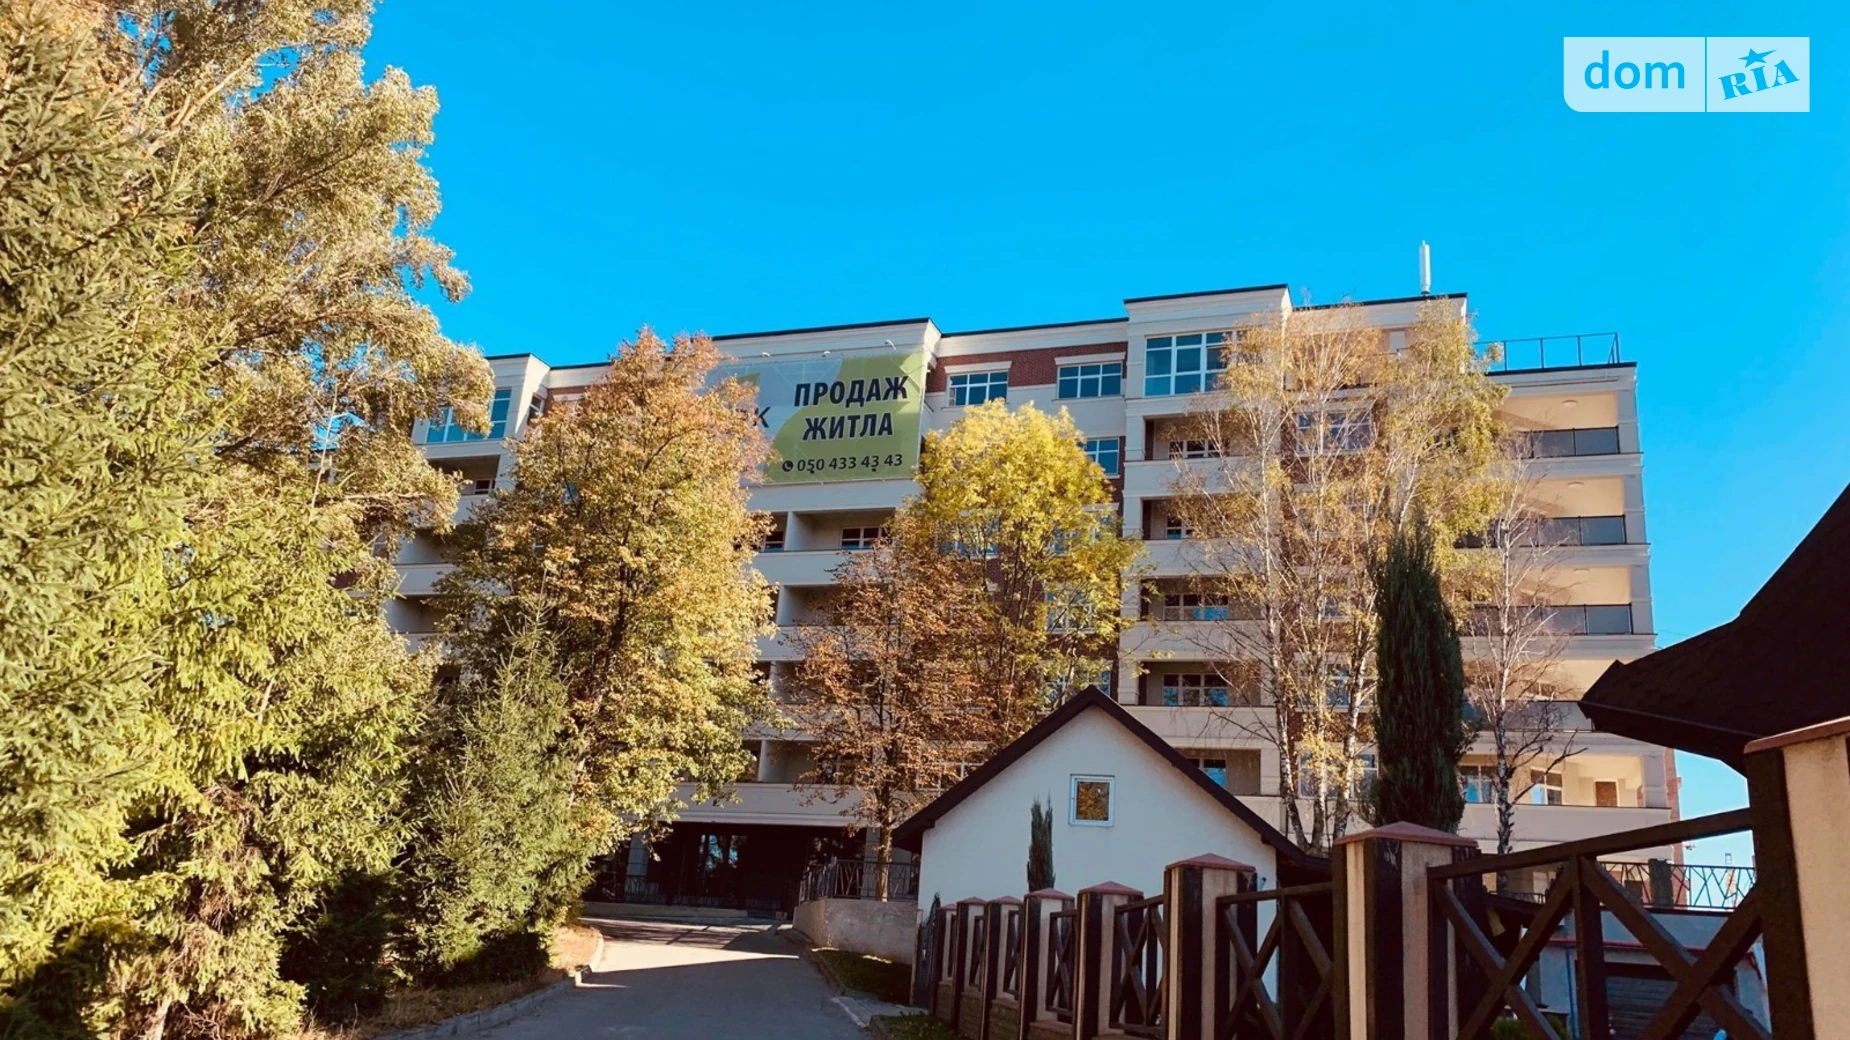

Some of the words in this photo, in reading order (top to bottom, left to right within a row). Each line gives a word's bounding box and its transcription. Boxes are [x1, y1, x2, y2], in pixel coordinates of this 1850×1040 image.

[794, 375, 908, 408] ПРОДАЖ
[802, 412, 893, 441] ЖИТЛА
[797, 458, 825, 472] 050
[828, 456, 857, 470] 433
[861, 455, 880, 468] 43
[884, 453, 903, 467] 43
